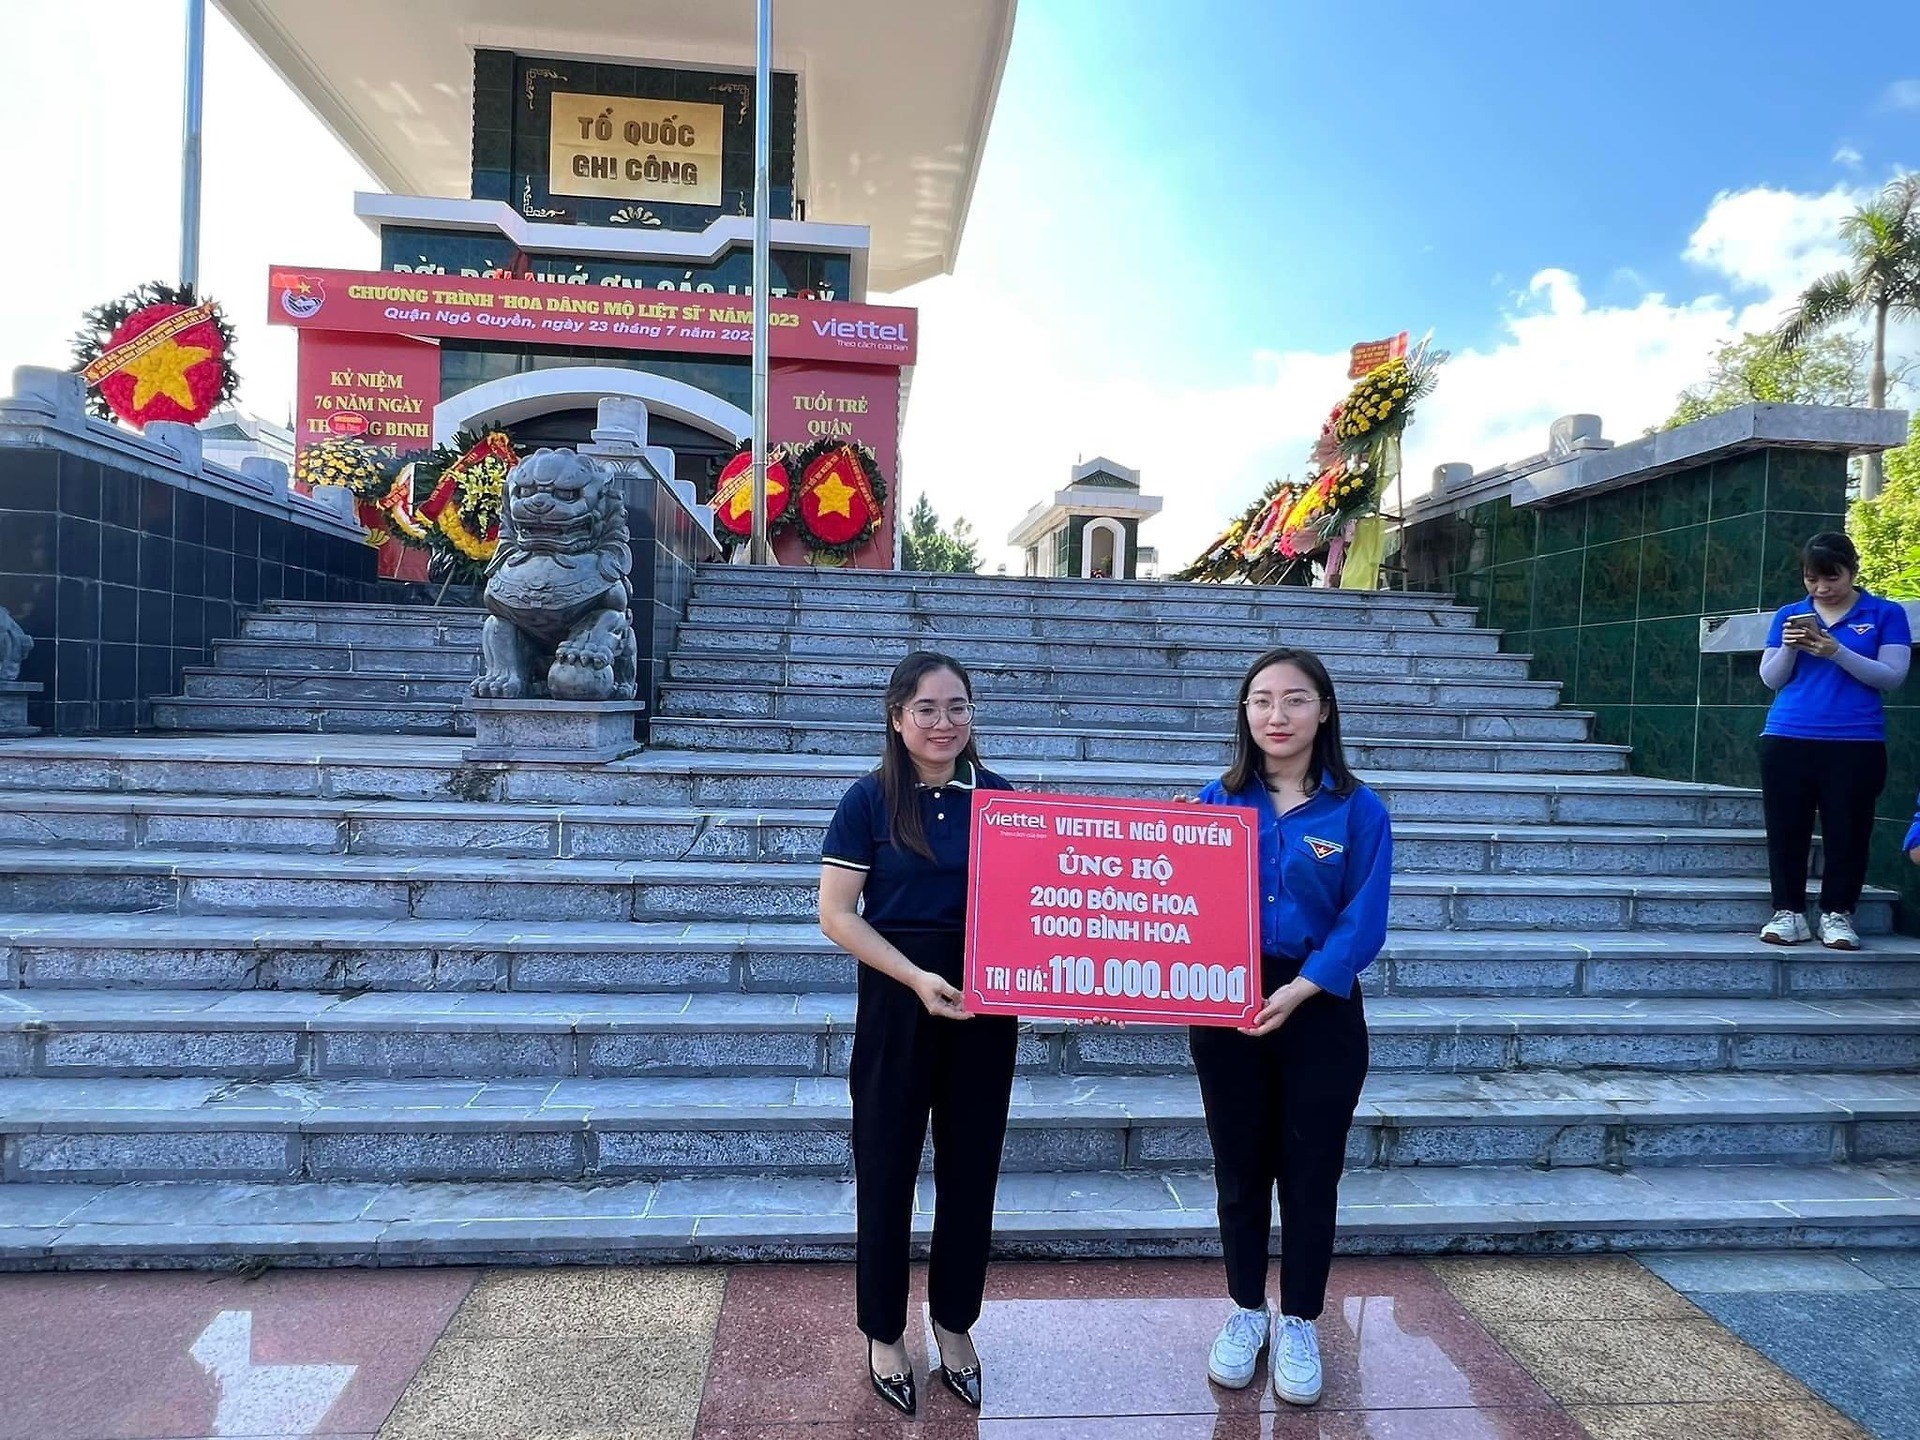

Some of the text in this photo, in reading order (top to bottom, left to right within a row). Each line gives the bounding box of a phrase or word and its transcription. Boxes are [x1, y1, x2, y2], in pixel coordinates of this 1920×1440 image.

[577, 107, 695, 147] TỔ QUỐC
[572, 154, 698, 186] GHI CÔNG
[348, 285, 428, 303] CHƯƠNG
[432, 288, 494, 307] TRÌNH
[546, 295, 600, 315] DÂNG
[603, 298, 635, 320] MỘ
[638, 302, 679, 322] LIỆT
[709, 306, 754, 324] NĂM
[768, 312, 800, 327] 023
[384, 307, 754, 341] Quận Ngô Quyền, ngày 23 tháng 7 năm 202
[812, 318, 908, 342] viettel
[330, 367, 404, 393] KỶ NIỆM
[314, 393, 424, 414] 76 NĂM NGÀY
[793, 390, 868, 414] TUỔI TRẺ
[306, 418, 381, 436] THG
[385, 421, 429, 438] BINH
[807, 418, 853, 440] QUẬN
[984, 811, 1048, 829] viettel
[1055, 816, 1124, 840] VIETTEL
[1129, 818, 1169, 843] NGÔ
[1172, 819, 1232, 847] QUYỀN
[1058, 846, 1174, 886] ỦNG HỘ
[1029, 886, 1199, 916] 2000 BÔNG HOA
[1030, 914, 1192, 945] 1000 BÌNH HOA
[985, 954, 1247, 1004] TRỊ GIÁ: 110.000.000đ
